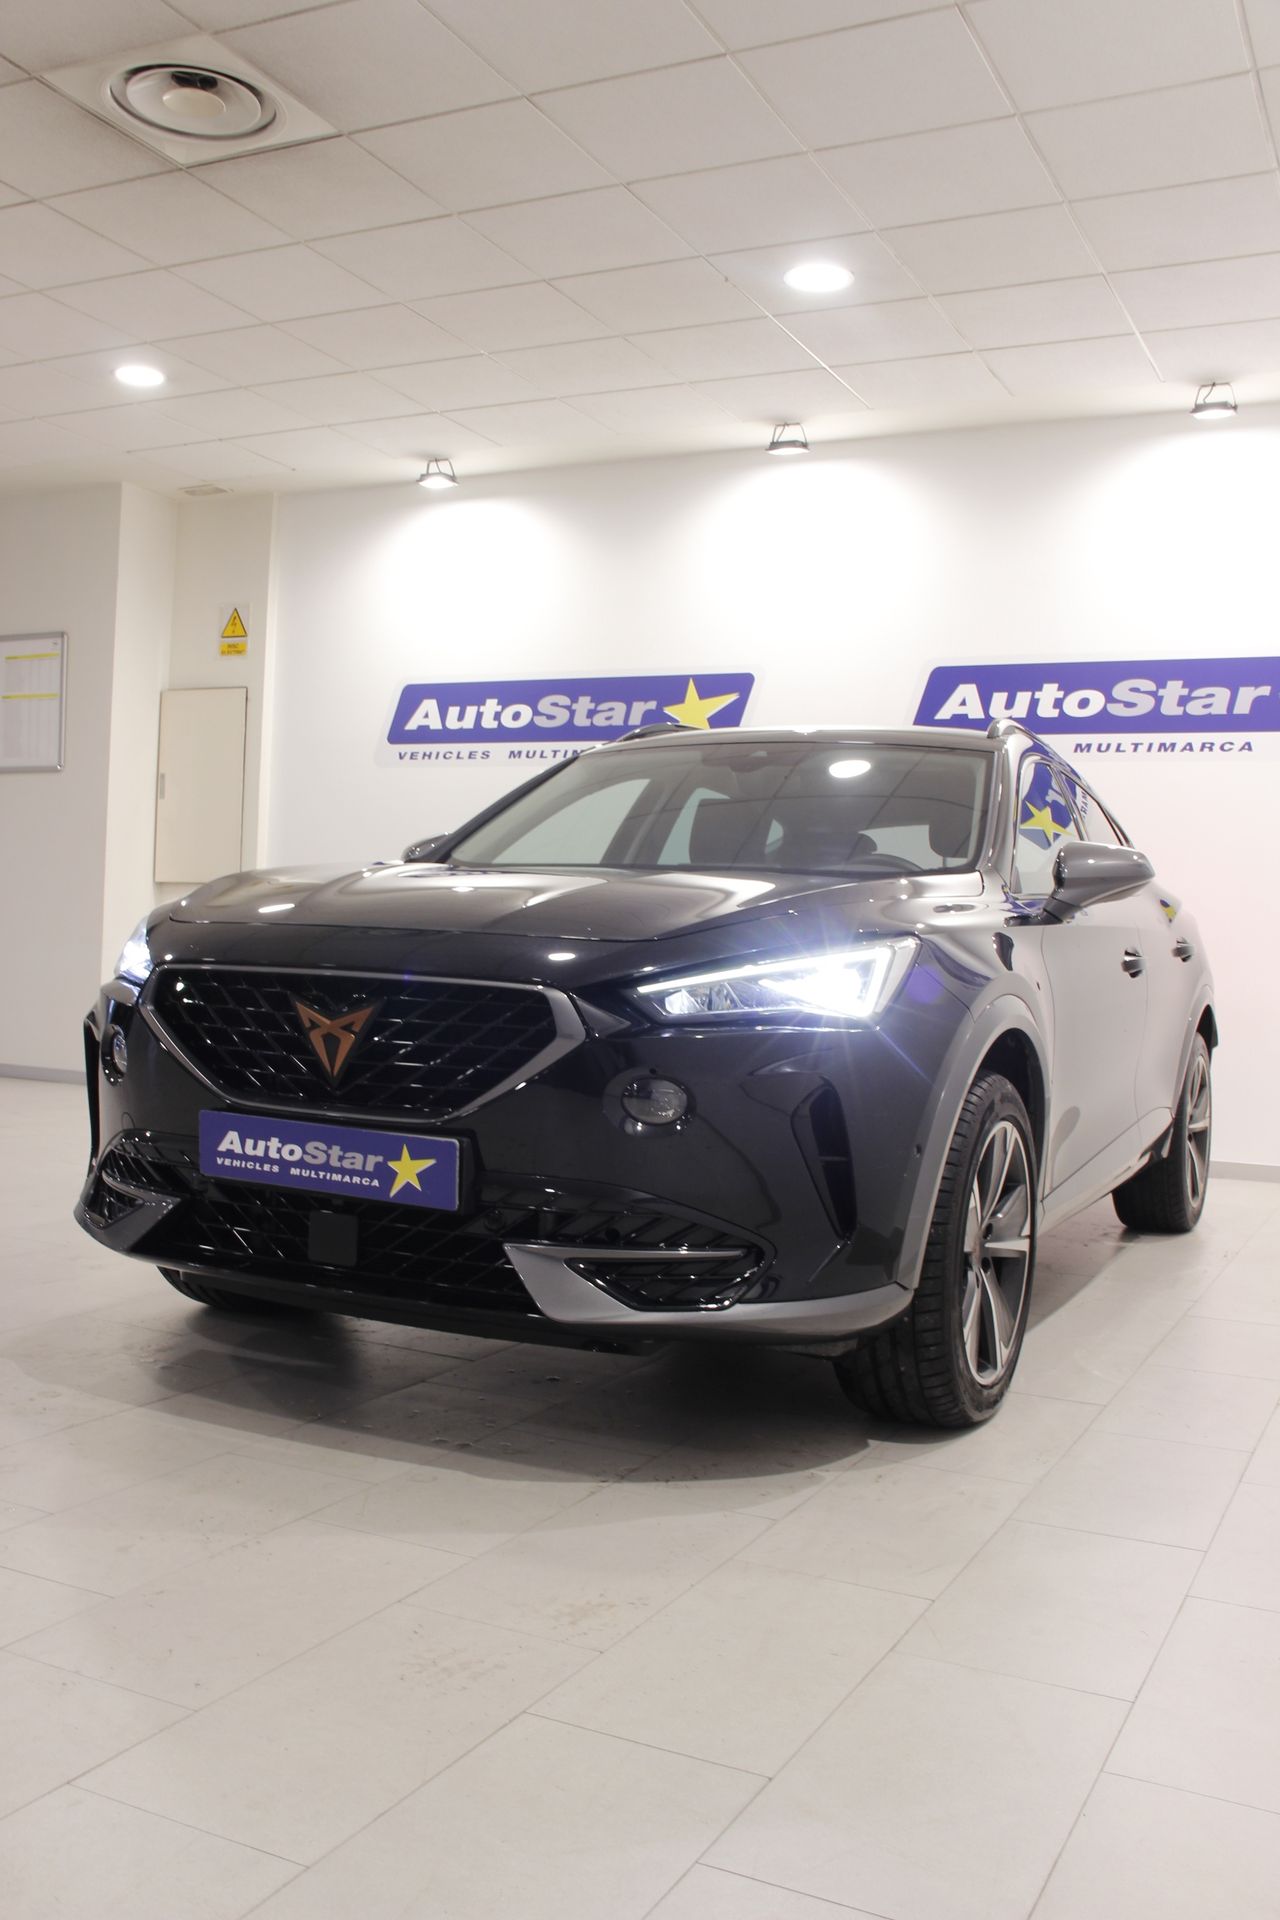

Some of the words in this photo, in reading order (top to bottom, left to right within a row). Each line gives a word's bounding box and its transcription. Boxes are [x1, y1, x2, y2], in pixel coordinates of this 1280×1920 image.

[403, 693, 658, 731] AutoStar
[933, 678, 1272, 720] AutoStar
[398, 750, 491, 761] VEHICLES
[1072, 740, 1255, 754] MULTIMARCA
[216, 1130, 384, 1172] AutoStar
[216, 1156, 280, 1173] VEHICLES
[289, 1167, 380, 1188] MULTIMARCA
